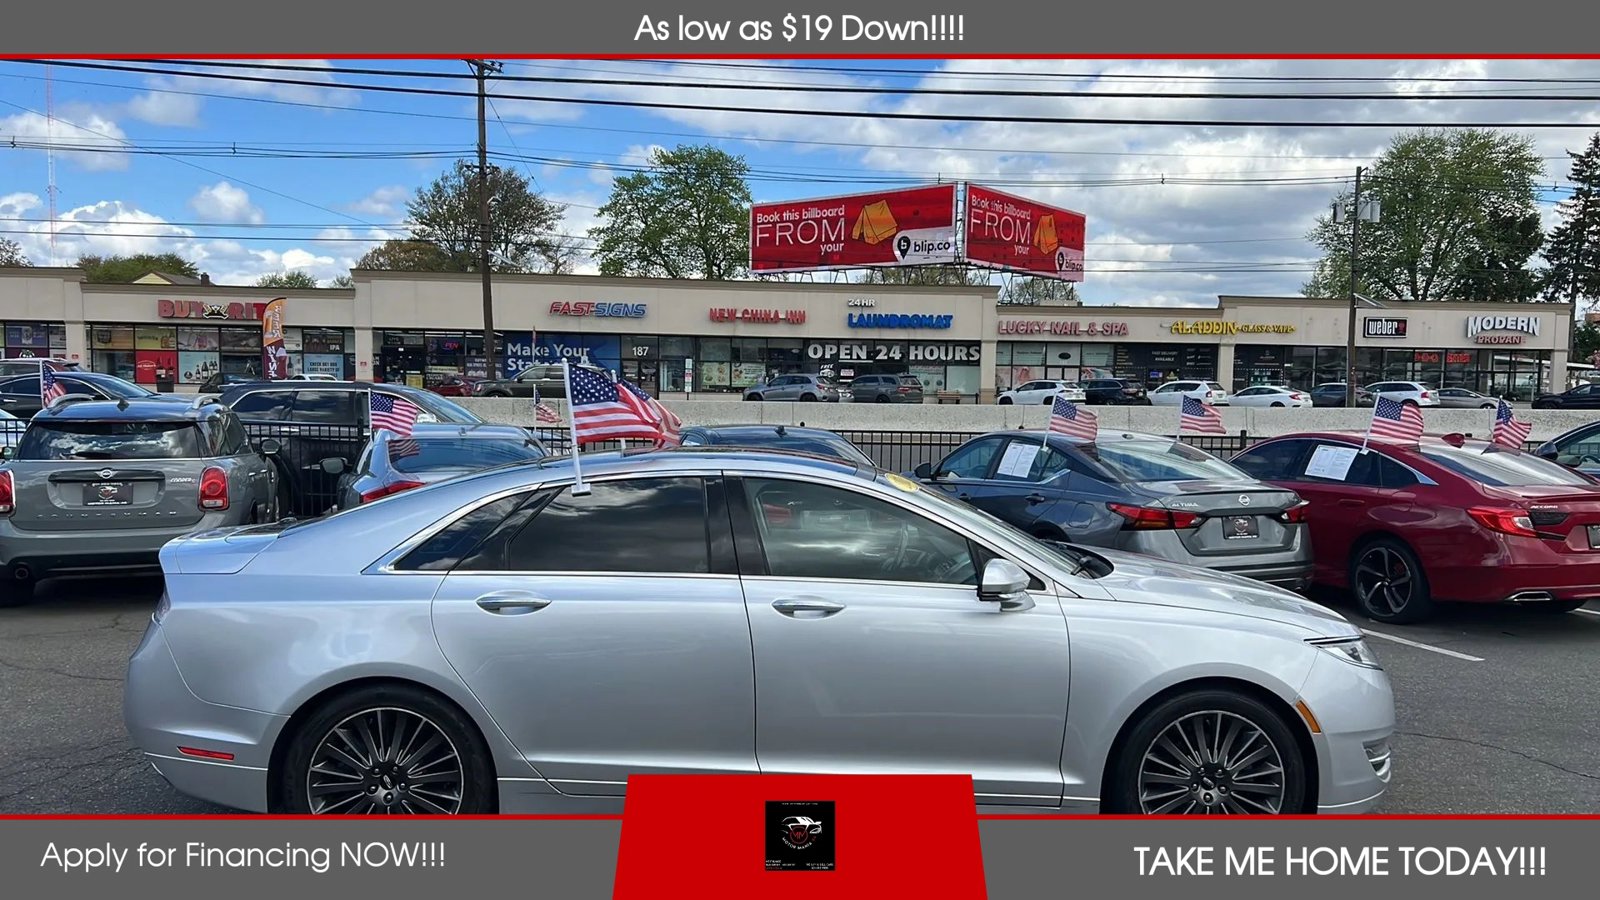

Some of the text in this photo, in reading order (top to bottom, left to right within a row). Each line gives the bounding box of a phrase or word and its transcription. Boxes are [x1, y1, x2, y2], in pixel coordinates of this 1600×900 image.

[756, 204, 845, 224] Book this billboard
[971, 195, 1031, 220] Book this billboard
[756, 217, 845, 248] FROM
[970, 208, 1031, 245] FROM
[820, 242, 845, 256] your
[912, 240, 951, 255] blip.co
[1014, 244, 1030, 257] your
[158, 299, 268, 320] BUY RIT
[549, 301, 648, 318] FASTSIGNS
[709, 307, 806, 324] NEW CHINA INN
[848, 312, 954, 329] LAUNDROMAT
[998, 320, 1130, 336] LUCKY NAIL & SPA
[1170, 319, 1237, 335] ALADDIN
[1368, 317, 1398, 335] weber
[1467, 315, 1541, 338] MODERN
[507, 342, 590, 357] Make Your
[632, 346, 650, 357] 187
[807, 343, 980, 361] OPEN 24 HOURS
